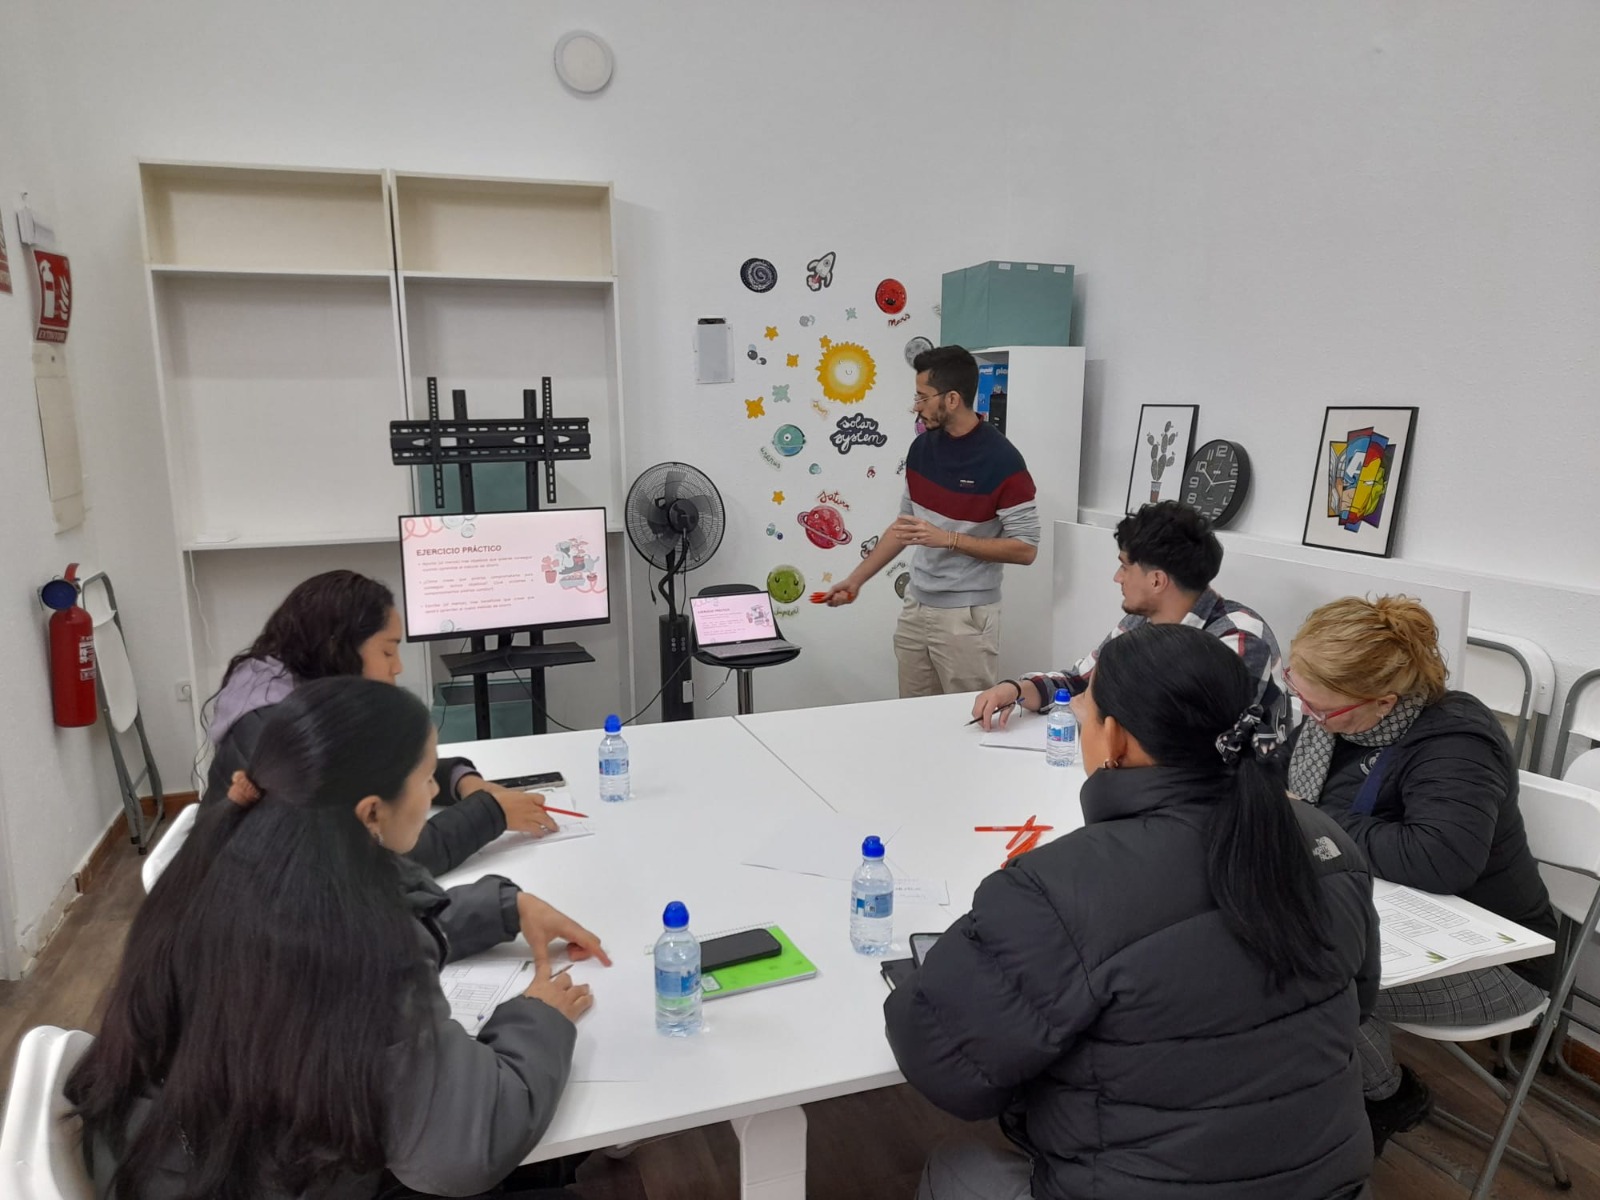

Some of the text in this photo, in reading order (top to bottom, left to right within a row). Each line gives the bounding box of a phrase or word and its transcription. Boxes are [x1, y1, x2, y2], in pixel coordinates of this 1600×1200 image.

[839, 415, 877, 430] solar
[833, 430, 885, 452] system
[1215, 445, 1228, 458] 12
[1196, 460, 1208, 473] 10
[1188, 476, 1199, 488] 9
[1187, 492, 1197, 504] 8
[416, 544, 502, 556] EJERCICIO PRÁCTICO
